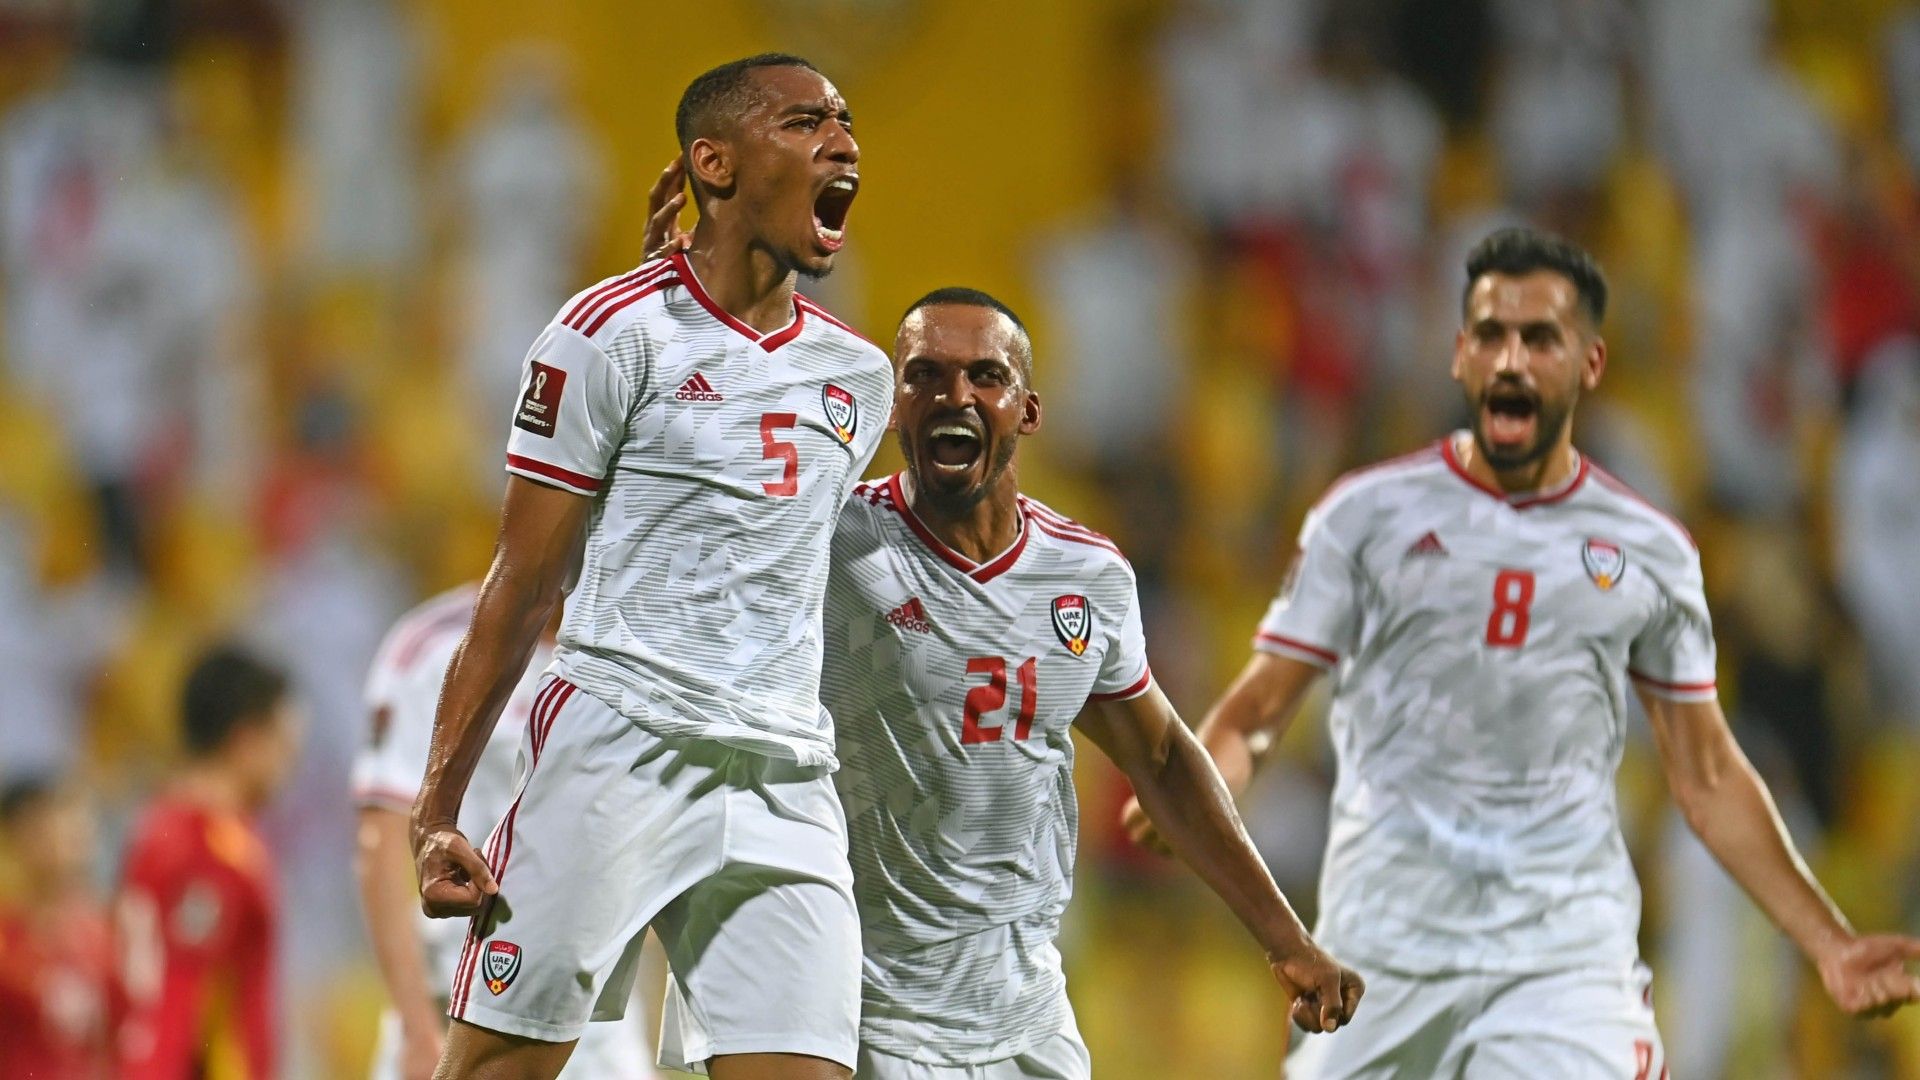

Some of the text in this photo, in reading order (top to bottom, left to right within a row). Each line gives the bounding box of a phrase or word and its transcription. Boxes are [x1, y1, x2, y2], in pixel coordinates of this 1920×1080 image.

[675, 390, 724, 402] adidas
[759, 412, 798, 497] 5
[1485, 568, 1536, 650] 8
[1062, 611, 1081, 621] UAE
[885, 612, 931, 635] adidas
[1068, 621, 1079, 629] FA
[961, 656, 1037, 745] 21
[492, 955, 511, 965] UAE
[494, 964, 504, 972] FA
